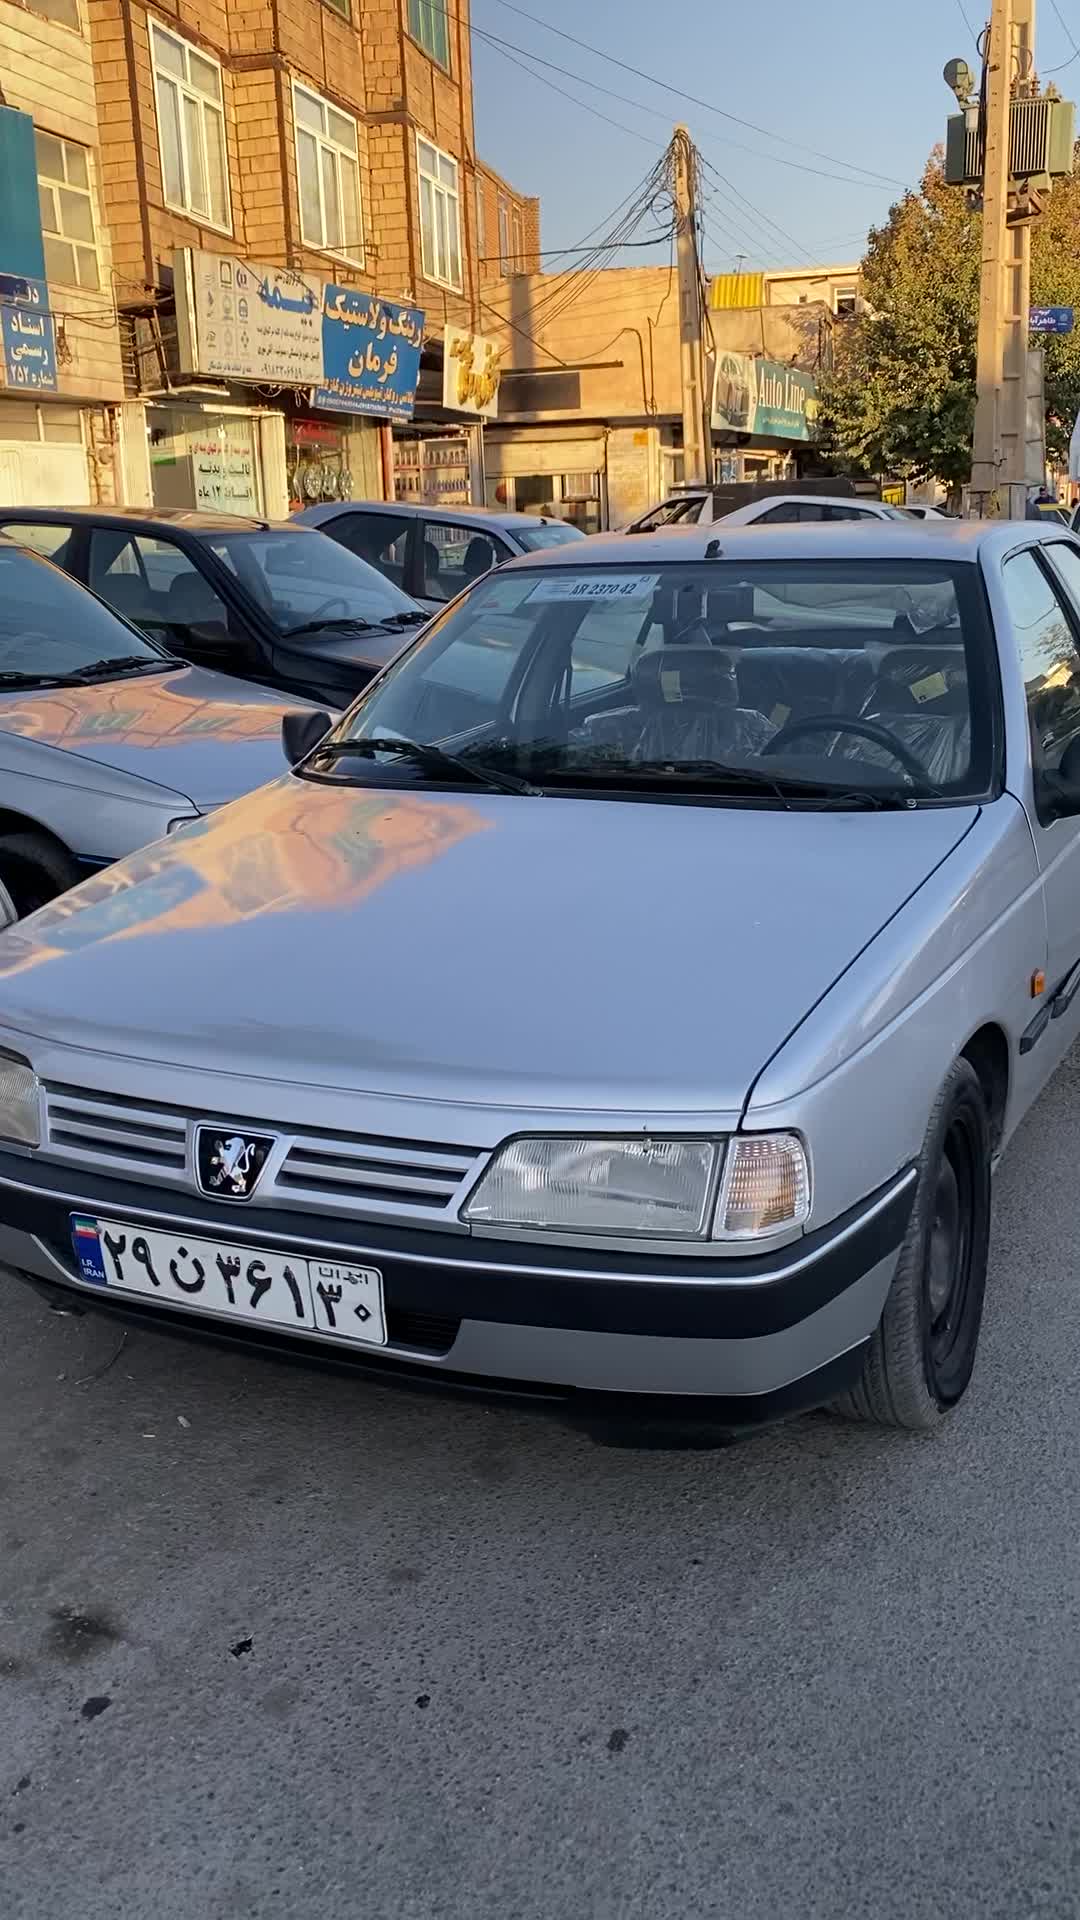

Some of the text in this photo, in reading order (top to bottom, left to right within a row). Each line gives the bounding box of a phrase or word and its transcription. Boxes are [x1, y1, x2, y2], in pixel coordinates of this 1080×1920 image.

[11, 312, 44, 336] اسناد
[325, 294, 421, 348] رینگ و لاستیک
[11, 343, 48, 365] رسمی
[348, 341, 398, 383] فرمان
[32, 369, 54, 388] شماره
[759, 367, 806, 414] Auto Line
[569, 584, 587, 596] AR
[588, 583, 619, 595] 2370
[620, 583, 638, 595] 42
[83, 1267, 105, 1279] IRAN
[317, 1281, 372, 1328] ۳۰
